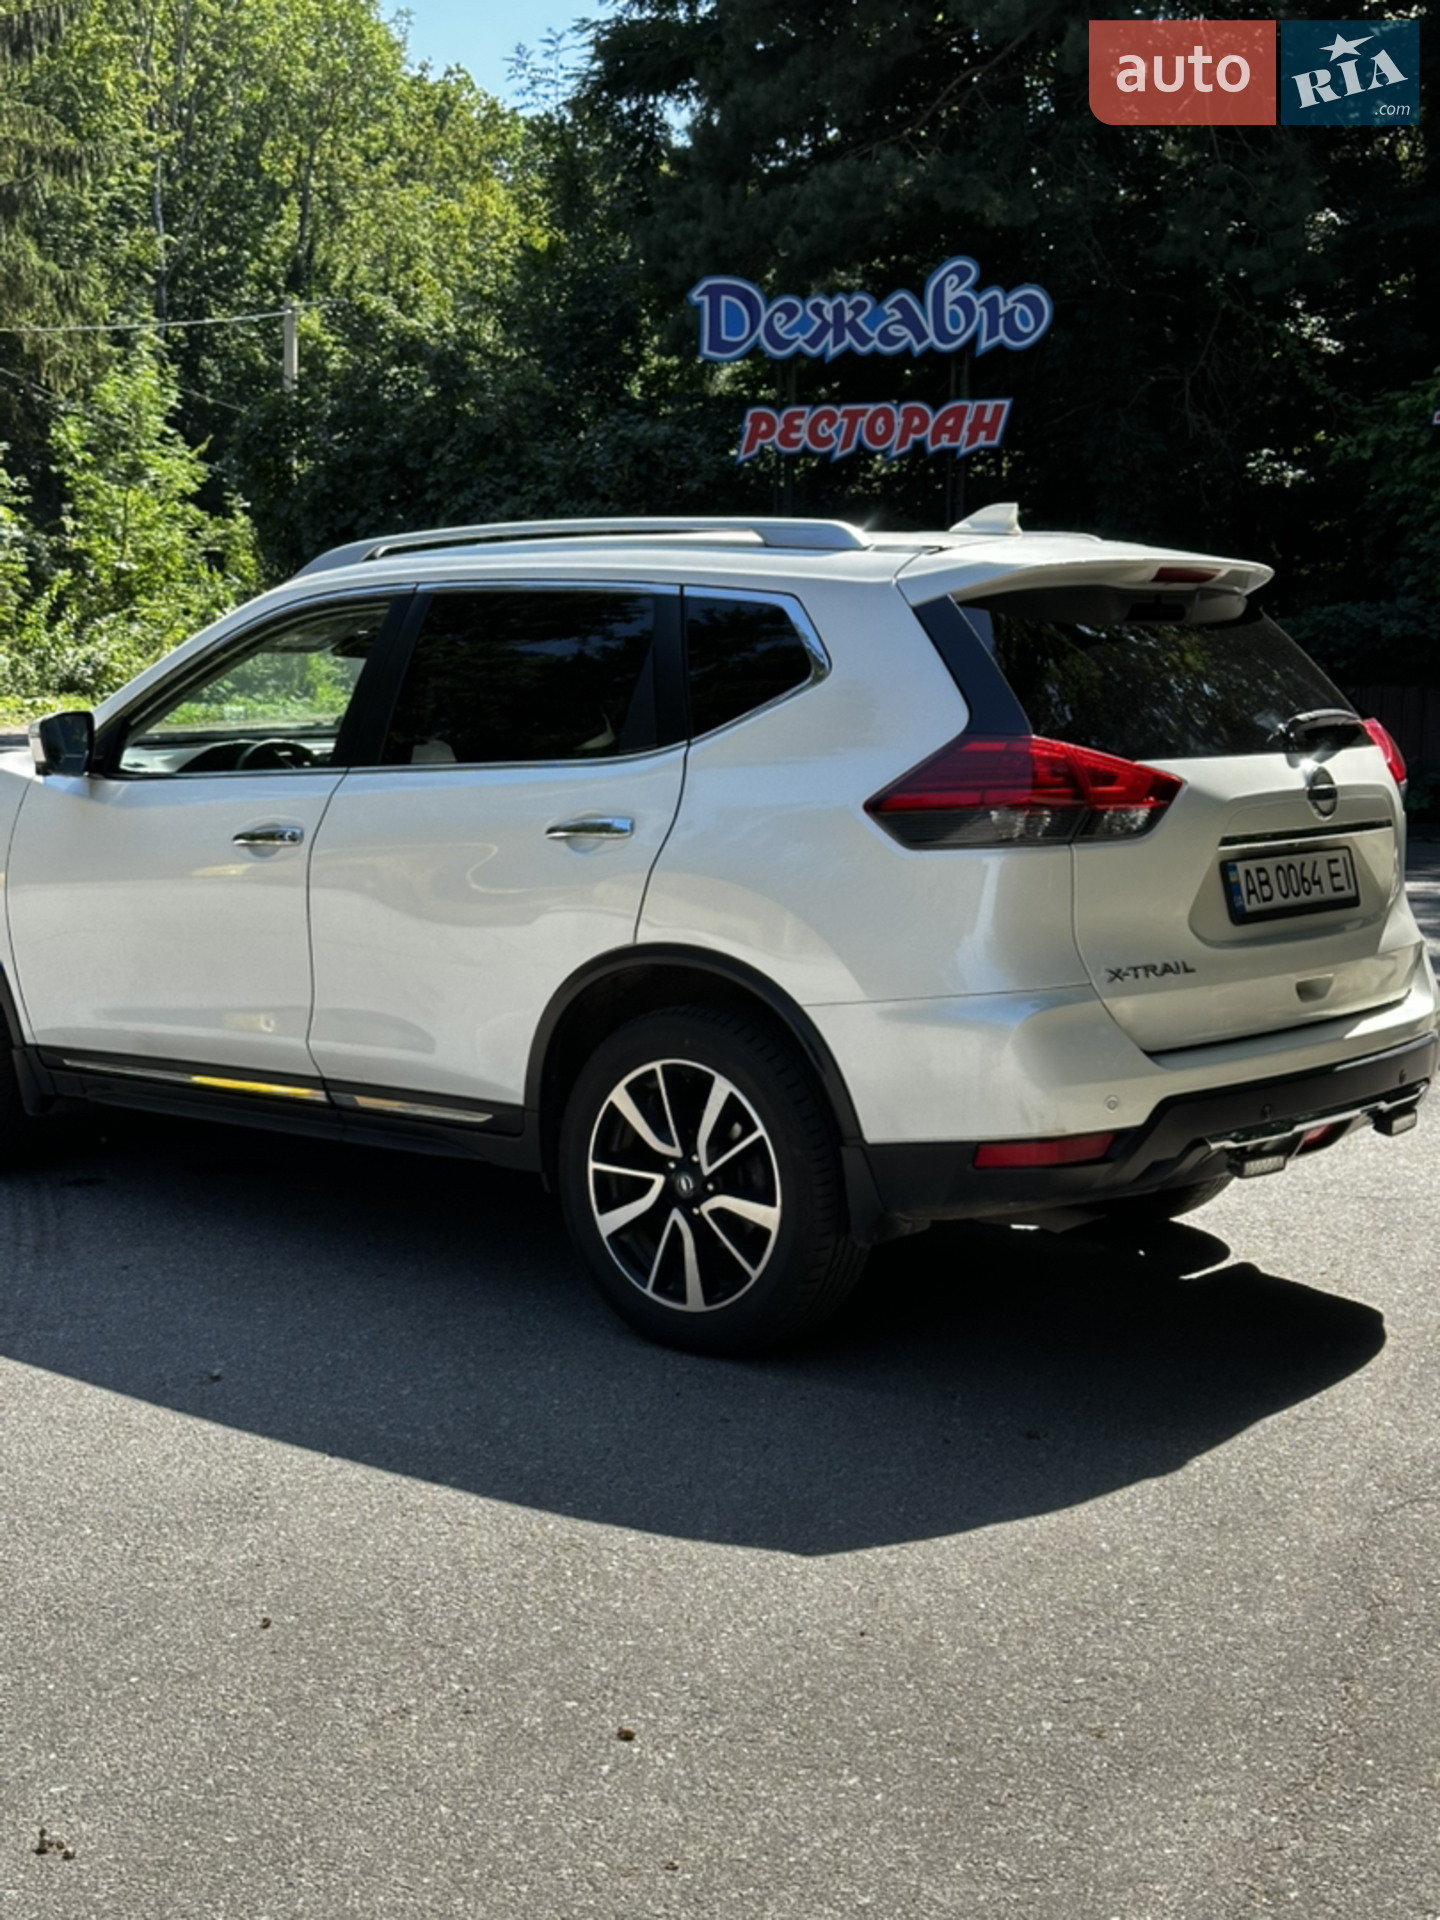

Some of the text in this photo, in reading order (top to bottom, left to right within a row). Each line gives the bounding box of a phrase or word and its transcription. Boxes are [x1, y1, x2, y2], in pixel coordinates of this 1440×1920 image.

[690, 256, 1052, 362] Дежавю
[736, 400, 1012, 464] РЕСТОРАН
[1244, 856, 1353, 906] AB 0064 EI
[1105, 960, 1197, 983] X-TRAIL
